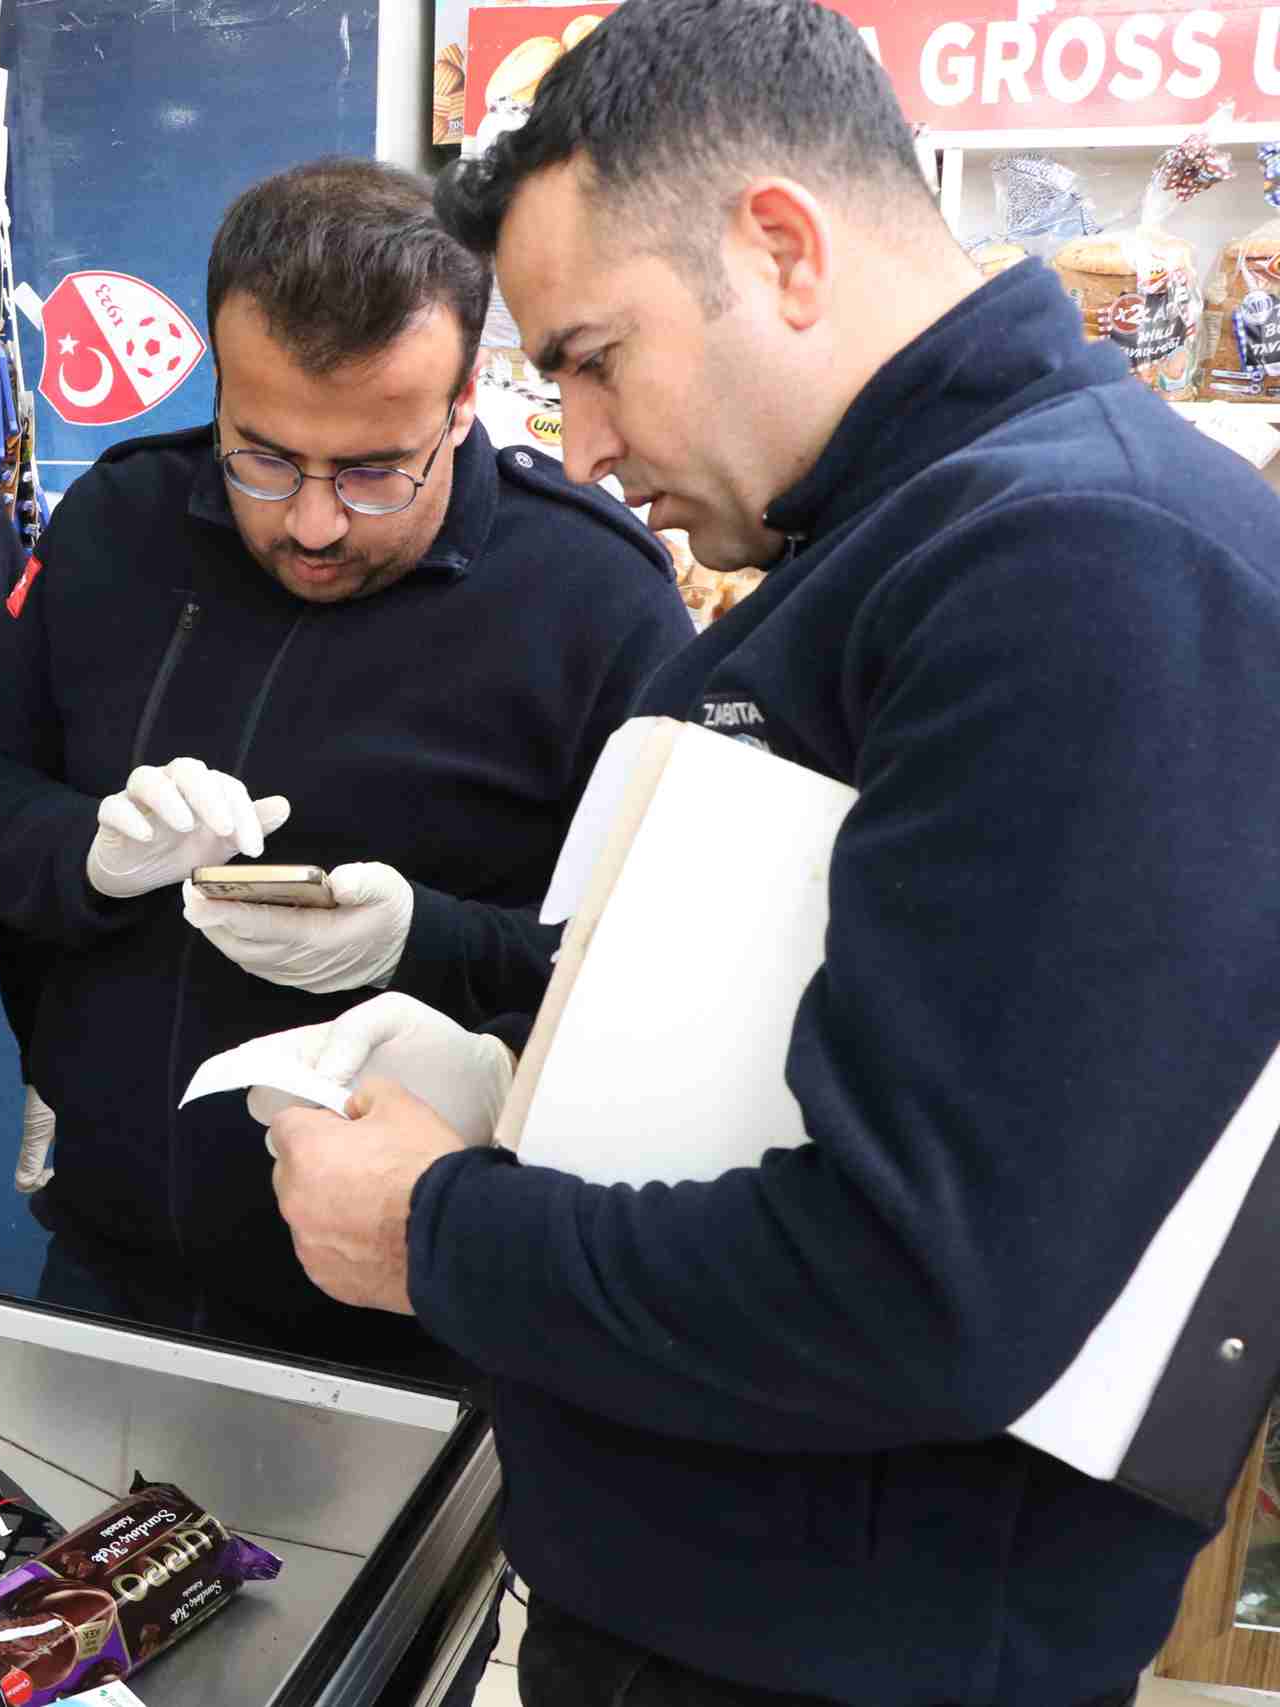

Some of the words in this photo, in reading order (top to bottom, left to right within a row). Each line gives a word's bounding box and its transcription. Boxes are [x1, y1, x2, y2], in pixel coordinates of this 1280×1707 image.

[920, 10, 1223, 106] GROSS
[95, 283, 124, 328] 1923
[533, 418, 562, 434] UN
[703, 702, 765, 726] ZABITA
[121, 1509, 177, 1544] Sandviç
[112, 1513, 231, 1601] LUPPO
